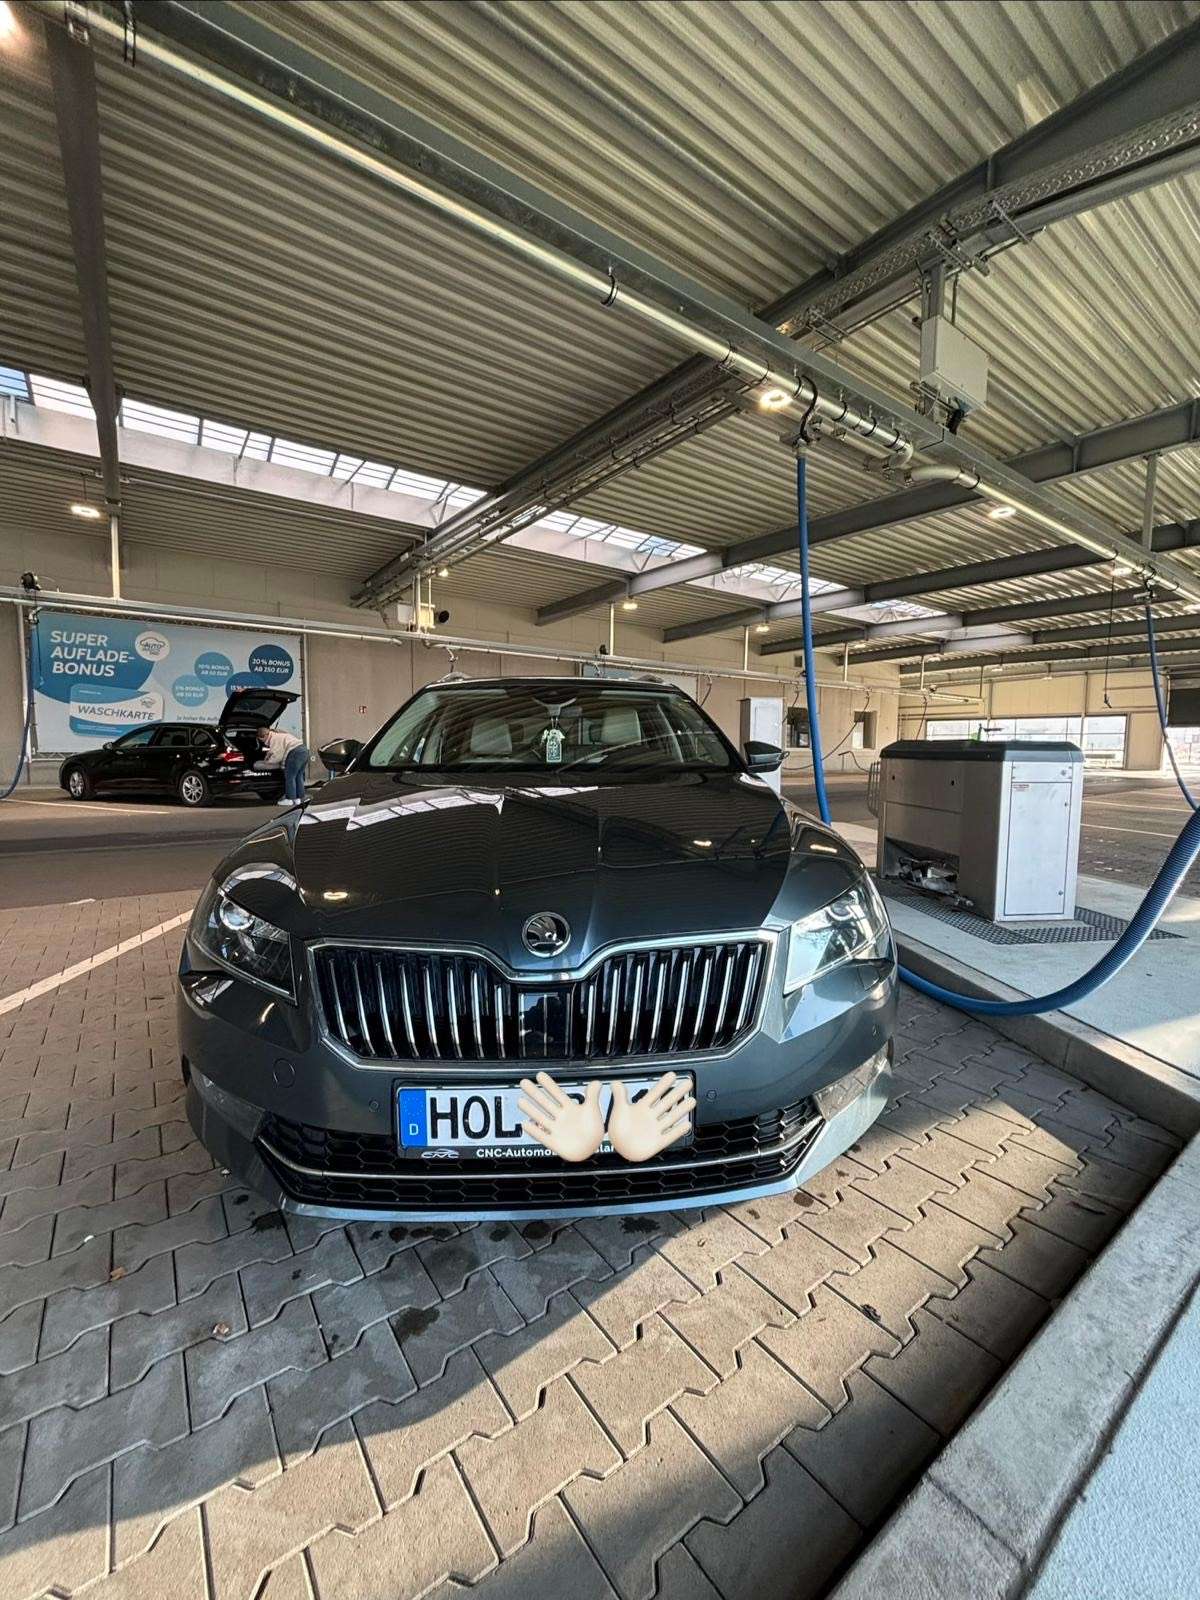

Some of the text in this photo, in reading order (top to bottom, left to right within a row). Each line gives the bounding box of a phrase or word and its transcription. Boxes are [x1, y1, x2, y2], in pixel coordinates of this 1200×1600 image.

[50, 630, 109, 647] SUPER
[50, 646, 136, 663] AUFLADE-
[52, 662, 115, 677] BONUS
[268, 659, 291, 667] BONUS
[78, 704, 156, 721] WASCHKARTE
[429, 1095, 523, 1140] HOL
[409, 1123, 419, 1136] D
[476, 1147, 559, 1158] CNC-Automo
